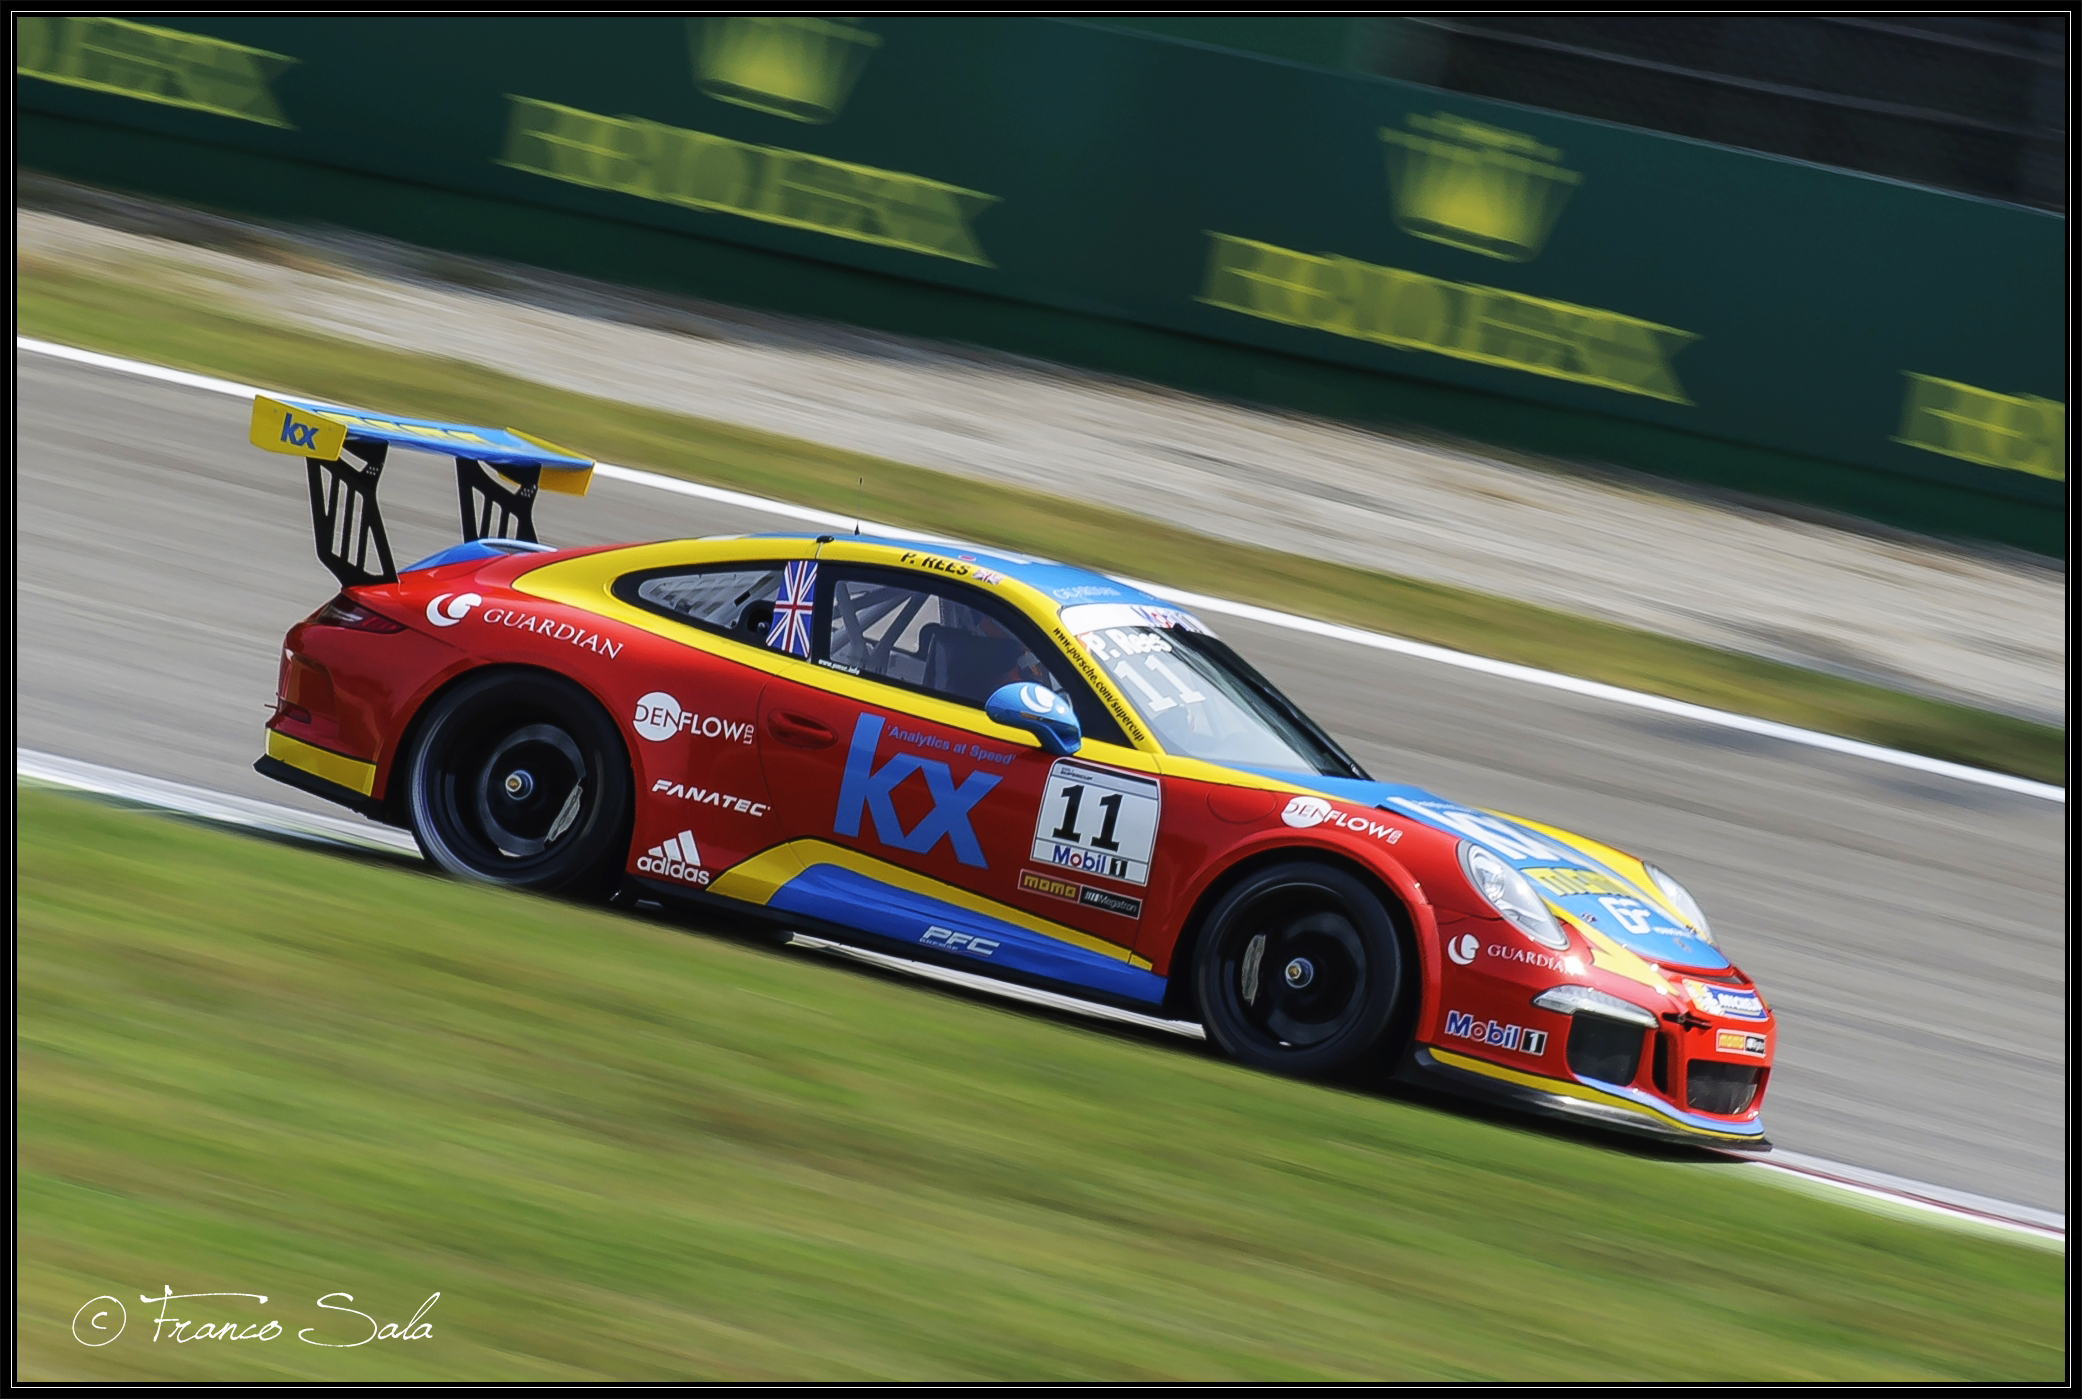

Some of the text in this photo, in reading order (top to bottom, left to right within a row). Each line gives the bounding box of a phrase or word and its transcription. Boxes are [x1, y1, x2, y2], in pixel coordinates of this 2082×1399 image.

[281, 412, 319, 451] kx
[483, 608, 624, 660] GUARDIAN
[1053, 627, 1146, 743] www.porsche.com/supercup
[1113, 654, 1206, 712] 11
[652, 778, 766, 817] FANATEC
[834, 712, 1002, 869] kx
[1052, 784, 1124, 853] 11
[637, 855, 710, 886] adidas
[1053, 844, 1107, 873] Mobil
[919, 925, 1001, 956] PFC
[1487, 943, 1586, 976] GUARDIA
[1445, 1010, 1521, 1050] Mobil
